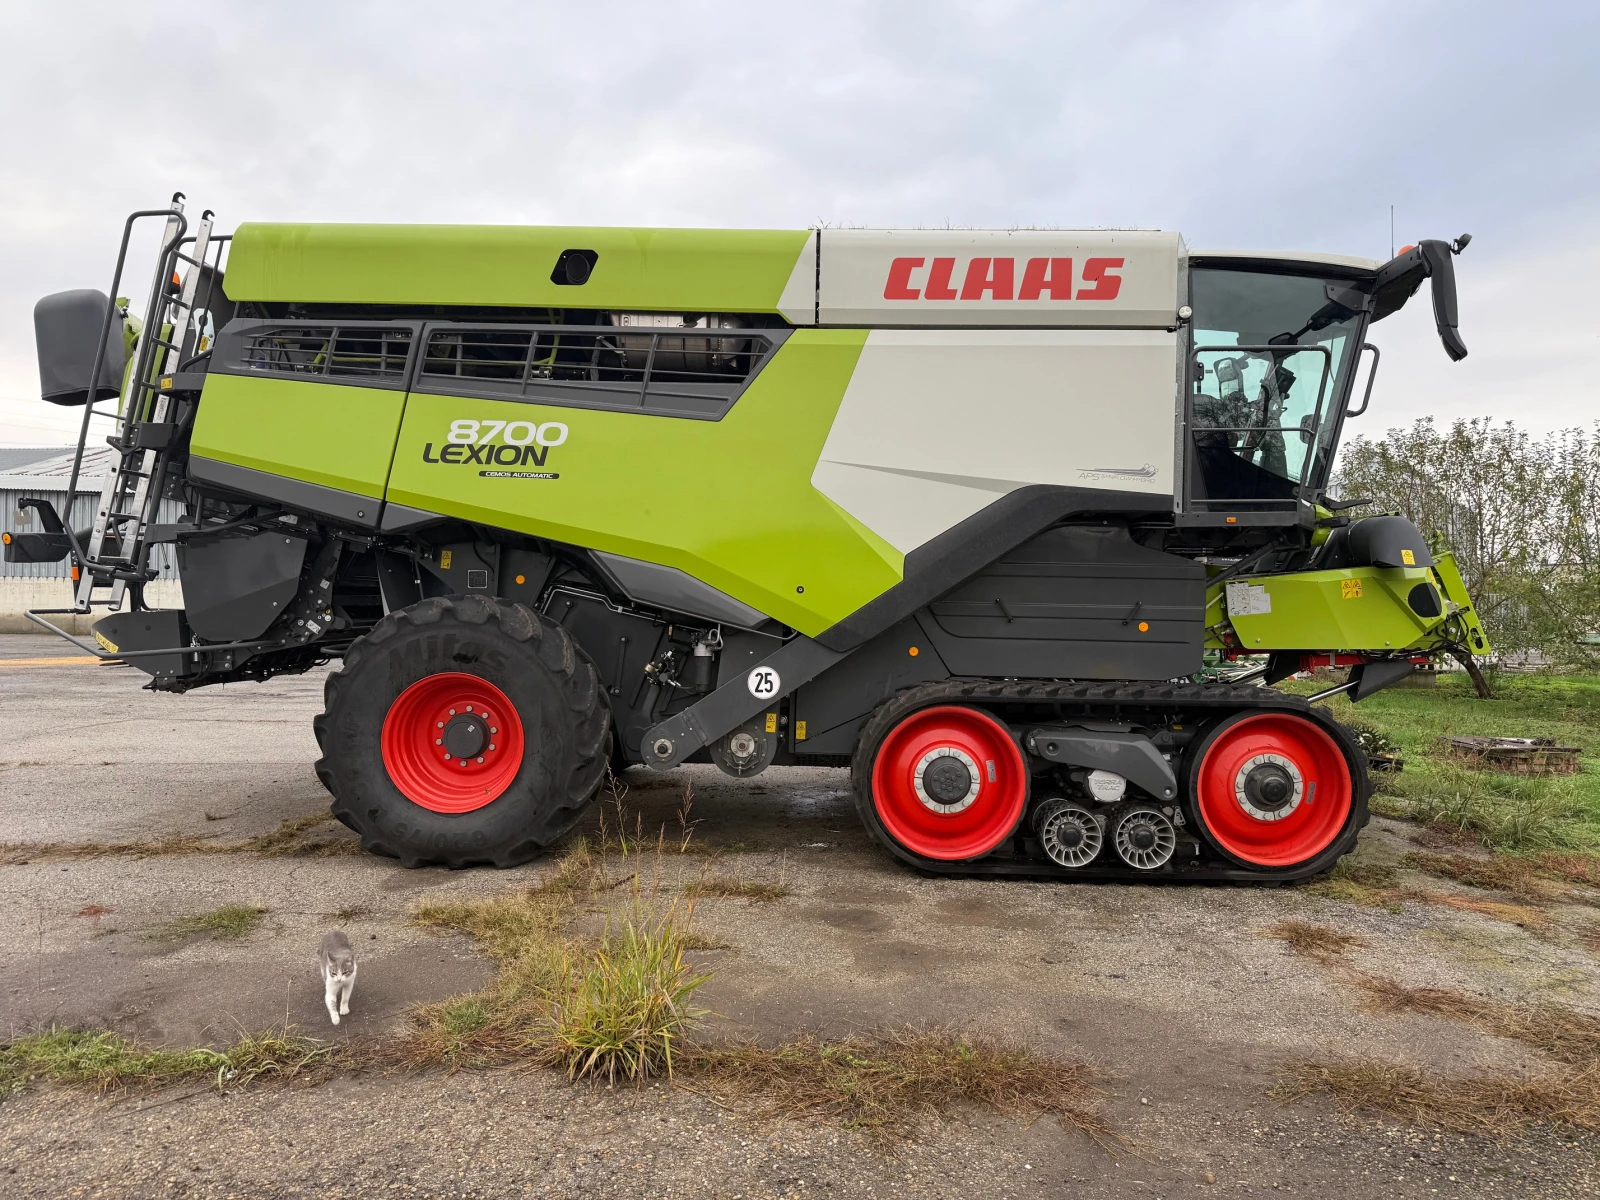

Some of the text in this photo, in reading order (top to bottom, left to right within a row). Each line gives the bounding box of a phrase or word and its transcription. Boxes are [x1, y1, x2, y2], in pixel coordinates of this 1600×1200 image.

[883, 257, 1125, 301] CLAAS
[447, 419, 569, 447] 8700
[422, 443, 550, 467] LEXION
[1078, 472, 1100, 481] APS
[389, 633, 511, 672] Mitas
[755, 672, 773, 693] 25
